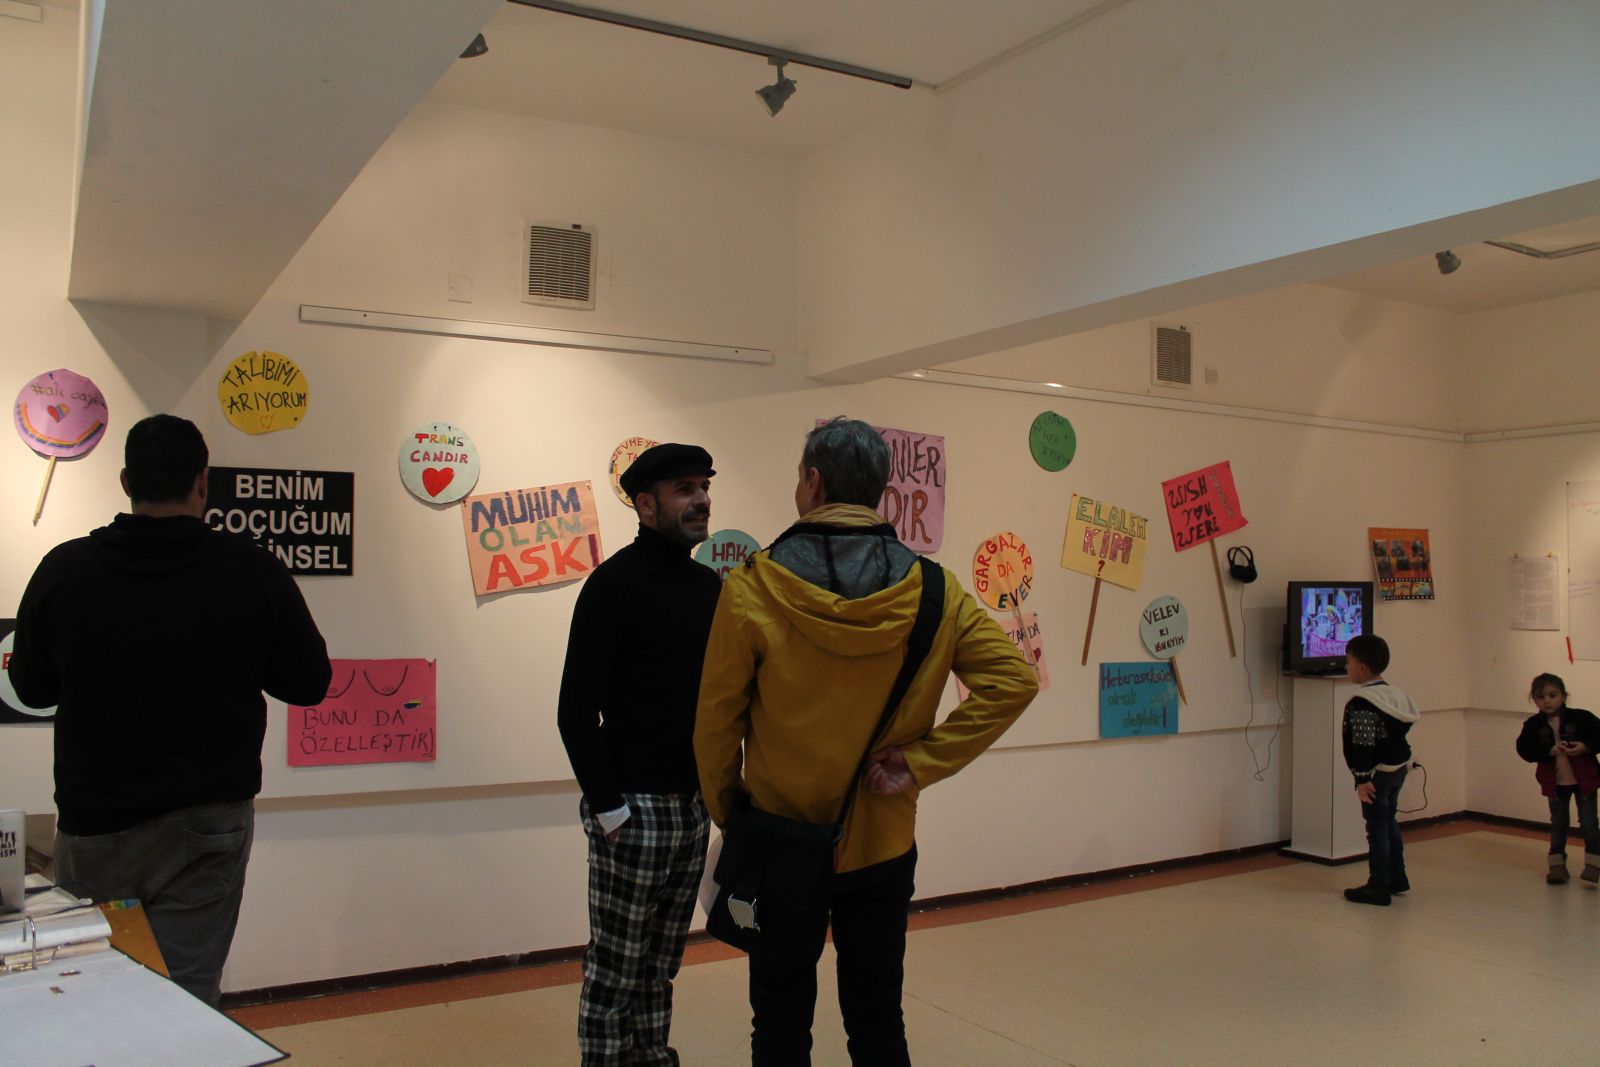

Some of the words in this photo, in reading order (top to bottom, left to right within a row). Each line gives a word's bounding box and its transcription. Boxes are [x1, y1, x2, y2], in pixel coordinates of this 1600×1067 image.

[227, 391, 306, 415] ARIYORUM
[414, 433, 465, 447] TRANS
[410, 450, 469, 465] CANDIR
[235, 470, 324, 501] BENİM
[471, 487, 581, 532] MÜHİM
[479, 515, 585, 552] OLAN
[997, 560, 1014, 578] DA
[1142, 603, 1180, 625] VELEV
[303, 708, 357, 730] BUNU
[376, 709, 406, 727] DA
